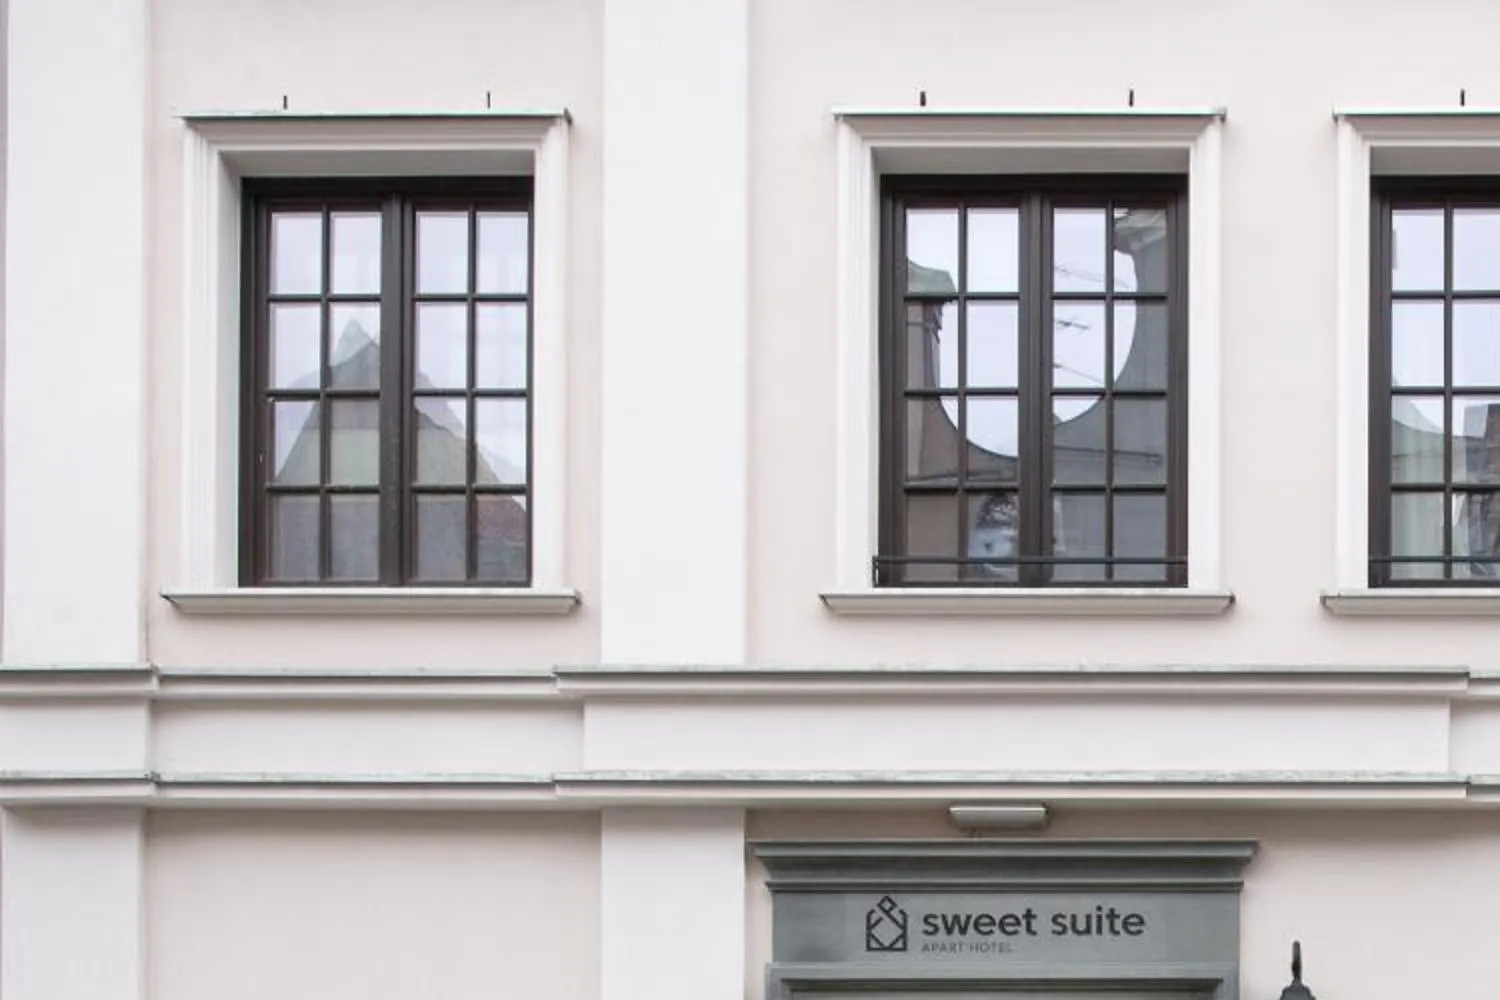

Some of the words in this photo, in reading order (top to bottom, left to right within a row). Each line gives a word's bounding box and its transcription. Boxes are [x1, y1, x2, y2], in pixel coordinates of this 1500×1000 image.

[922, 907, 1038, 937] sweet
[1051, 905, 1146, 937] suite
[922, 941, 965, 954] APART
[968, 941, 1013, 954] HOTEL
